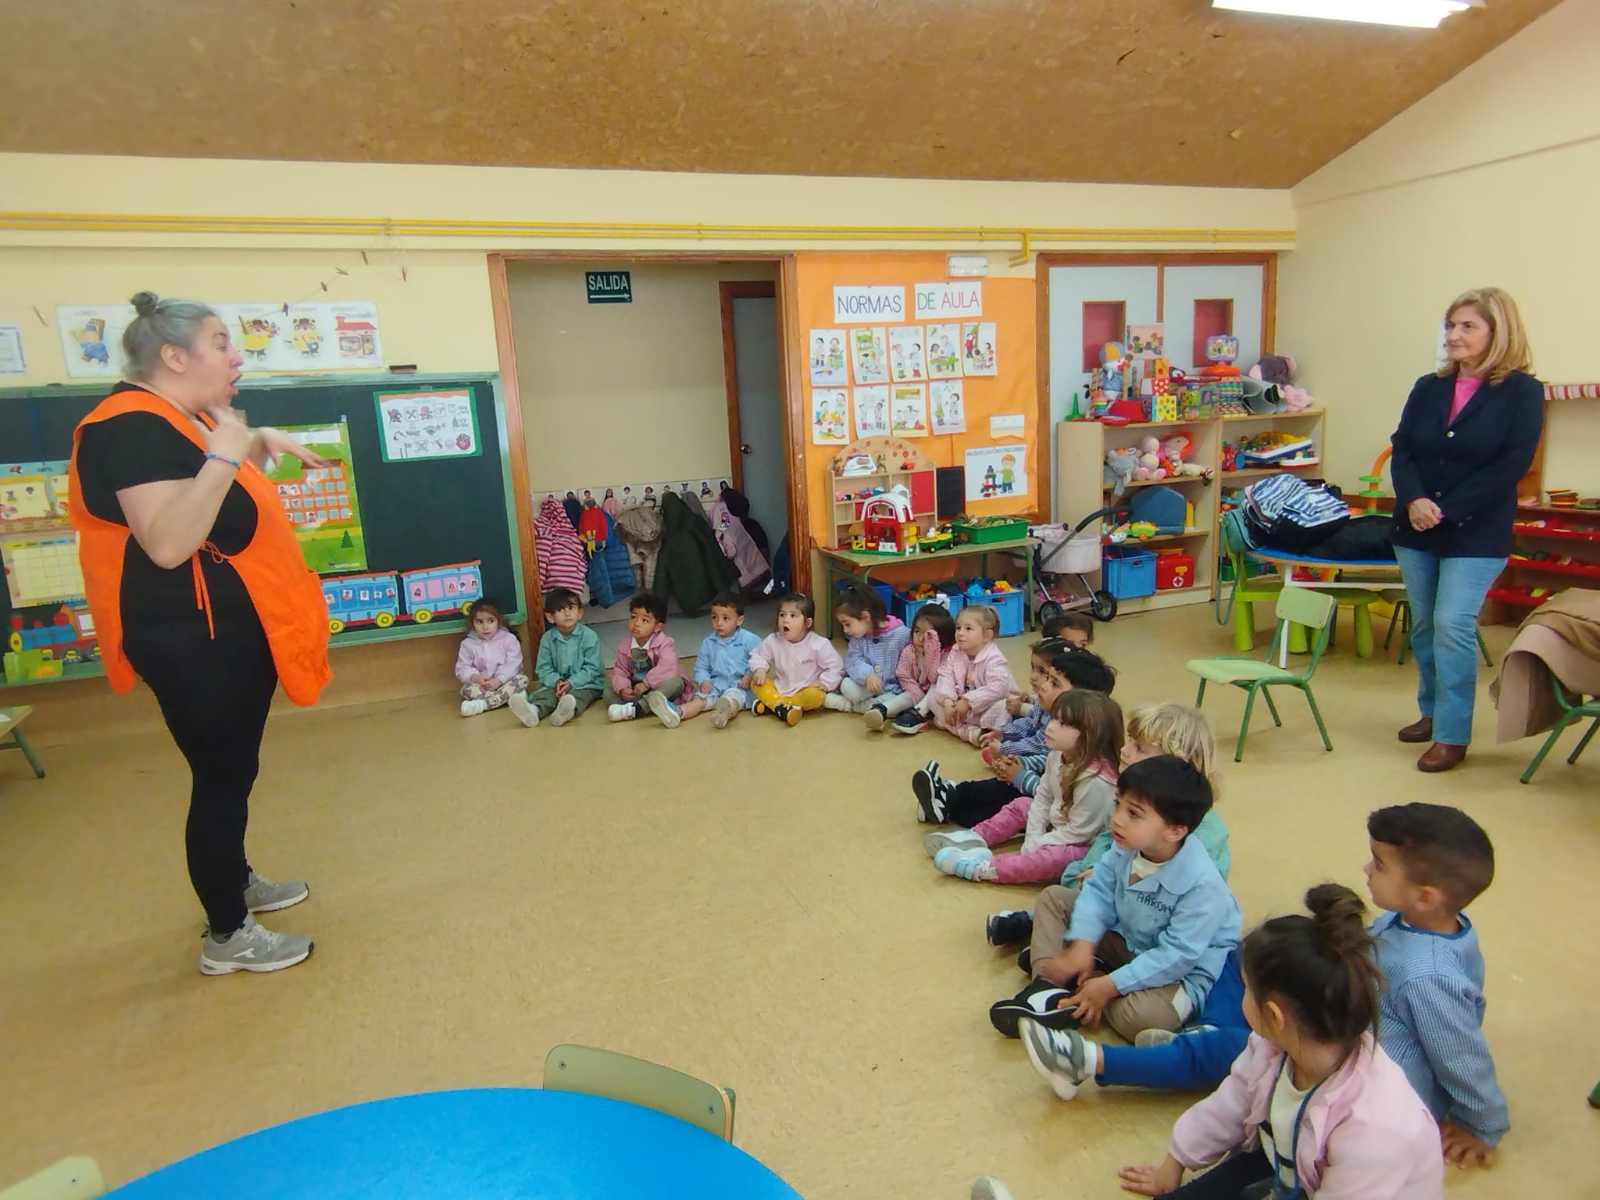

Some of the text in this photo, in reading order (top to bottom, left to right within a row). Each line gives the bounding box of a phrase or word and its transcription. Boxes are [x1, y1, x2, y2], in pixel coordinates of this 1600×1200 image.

[588, 274, 629, 291] SALIDA
[837, 290, 980, 315] NORMAS DE AULA
